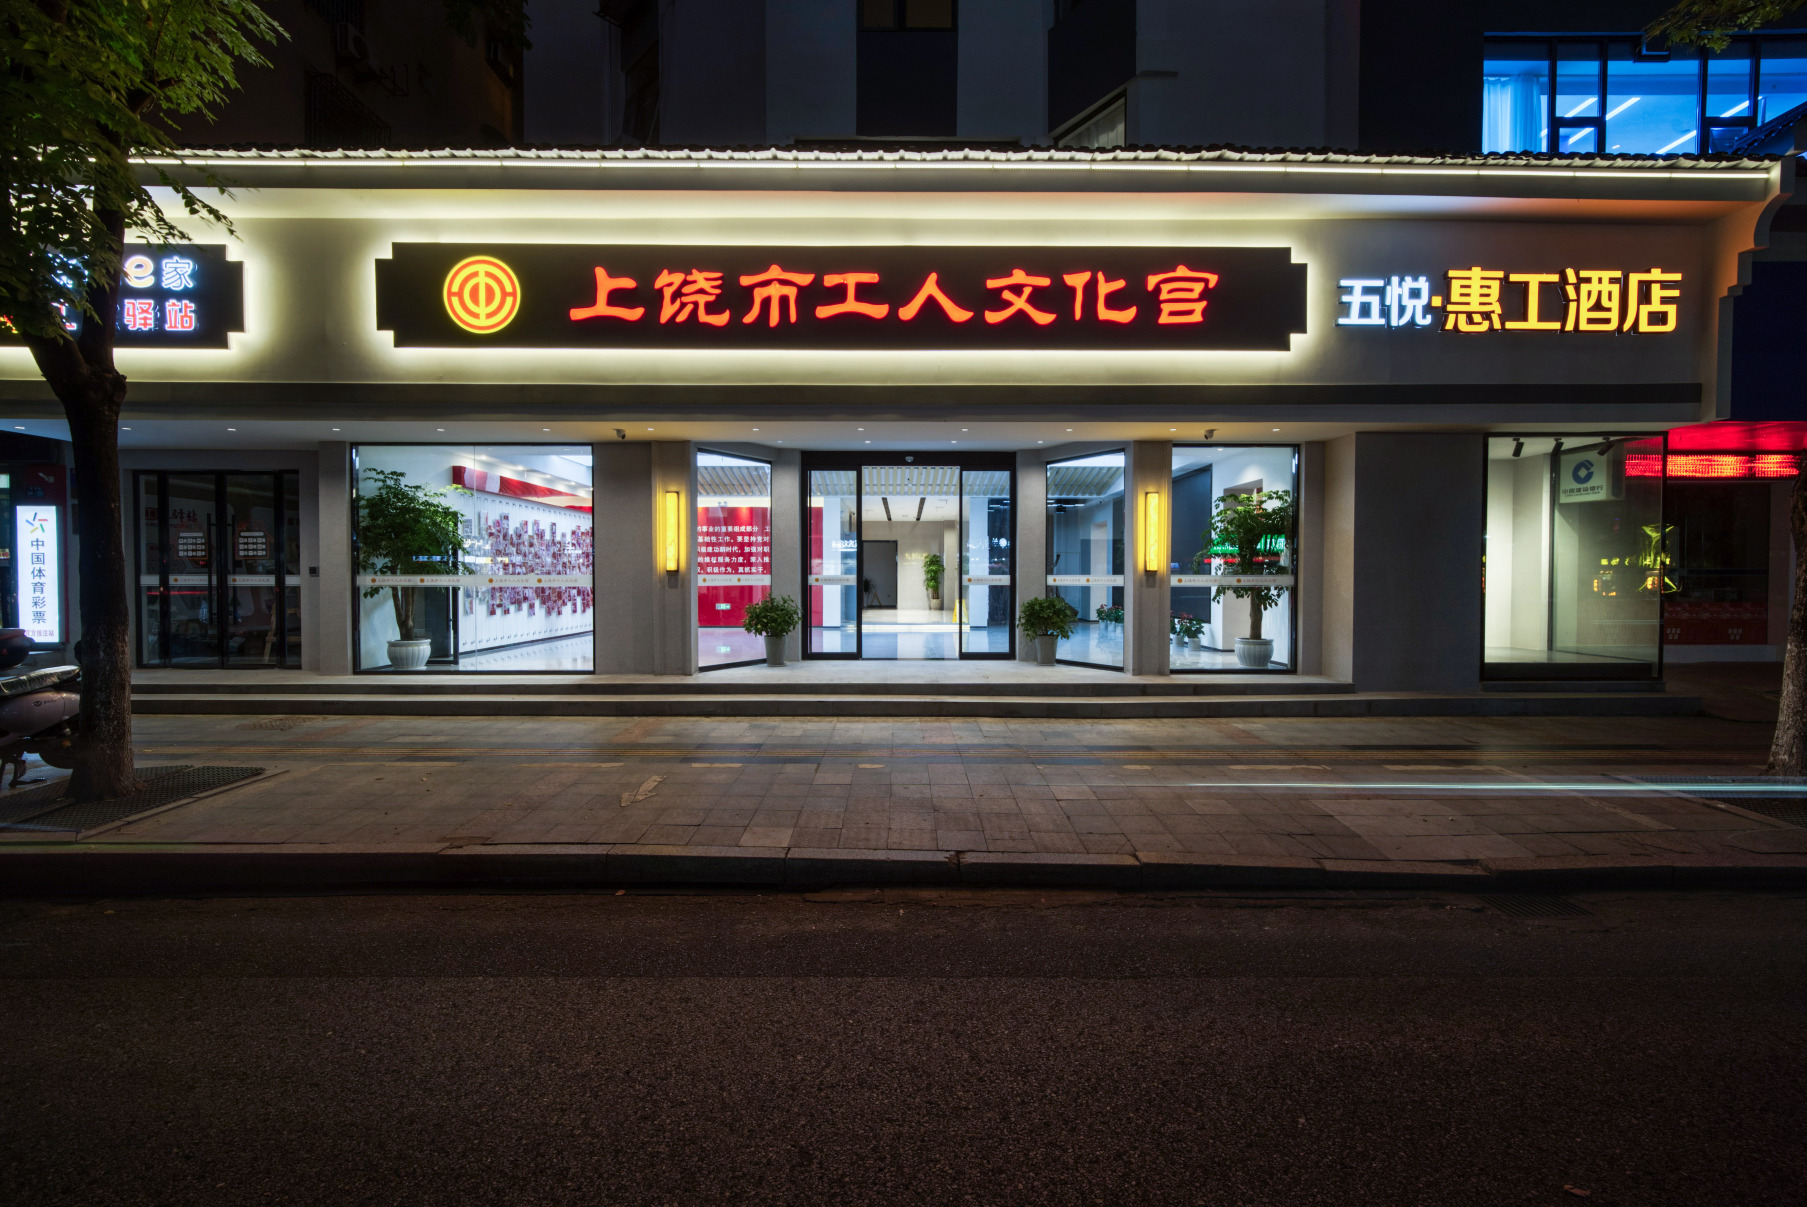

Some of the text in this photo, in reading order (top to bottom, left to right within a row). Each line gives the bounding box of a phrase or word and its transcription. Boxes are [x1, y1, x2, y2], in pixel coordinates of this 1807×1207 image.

[569, 264, 1219, 327] 上饶市工人文化宫
[30, 537, 47, 624] 中国体育彩票
